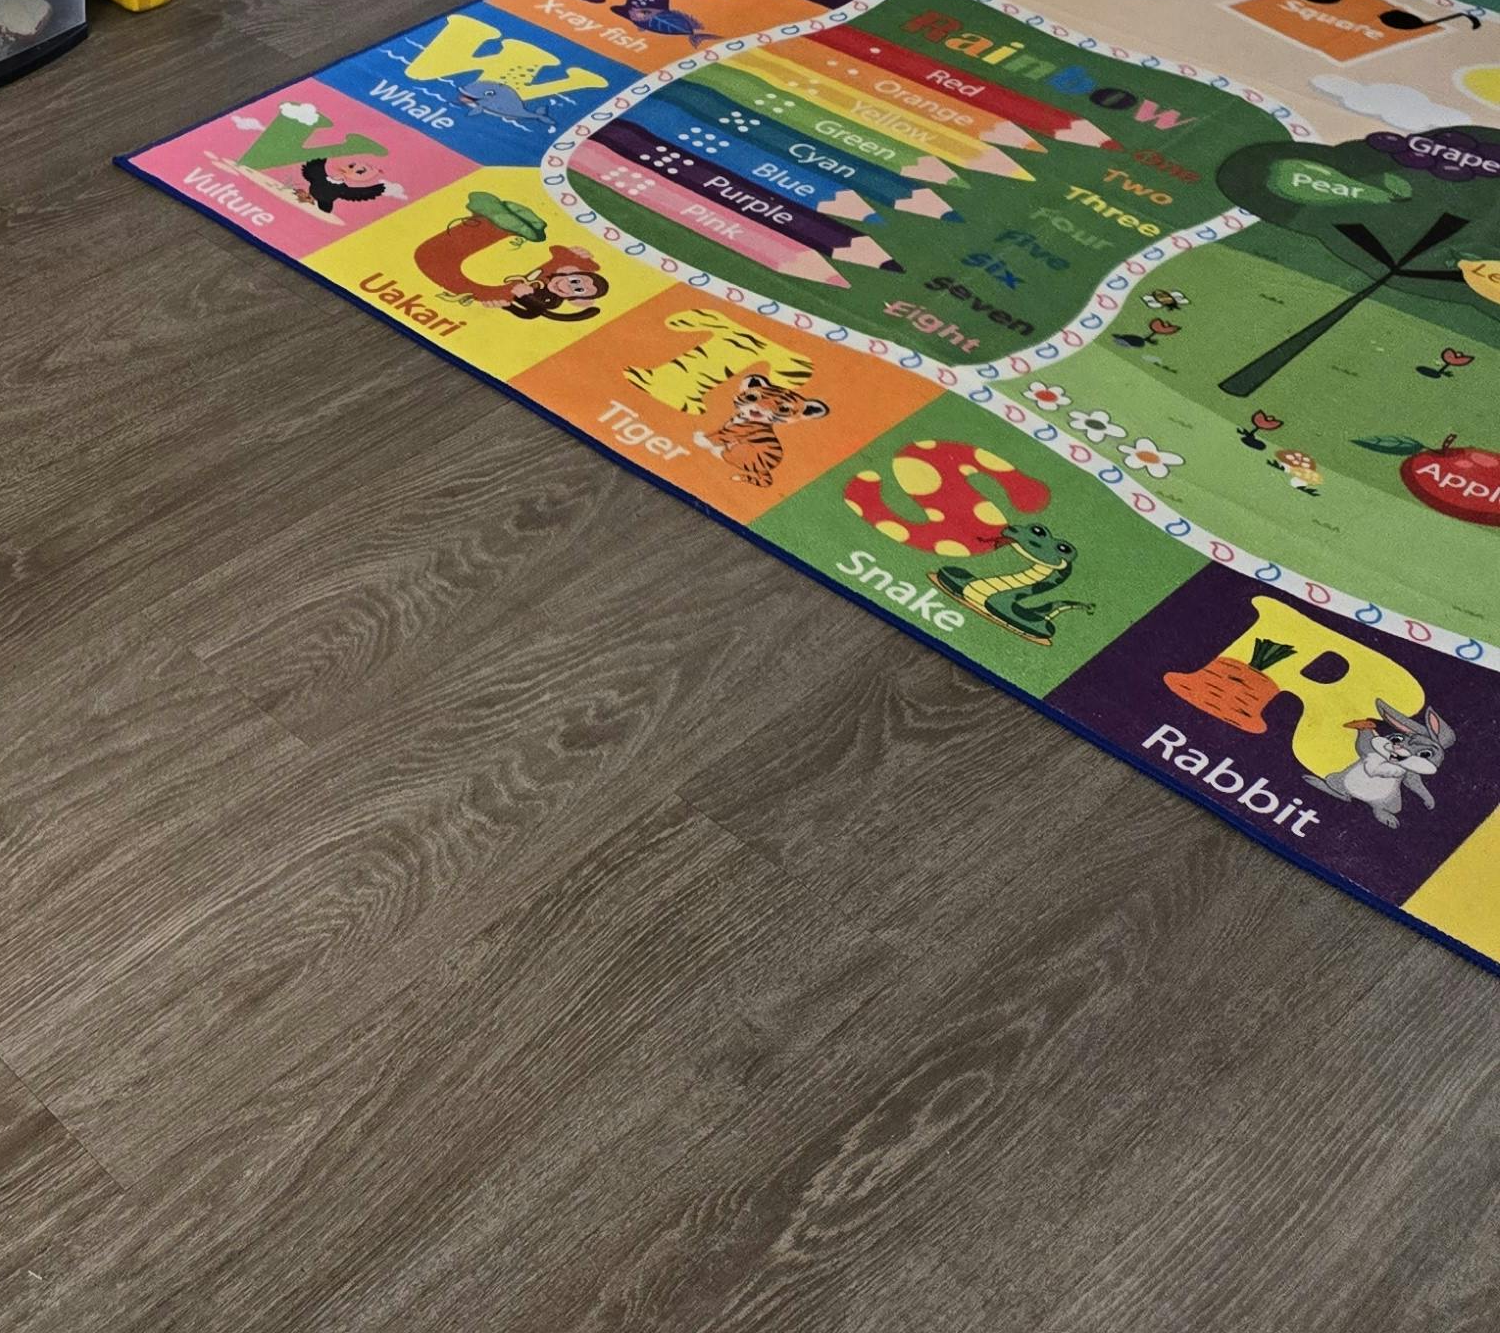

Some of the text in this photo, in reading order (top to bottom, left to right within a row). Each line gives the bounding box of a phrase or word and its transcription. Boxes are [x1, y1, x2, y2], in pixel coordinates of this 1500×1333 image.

[601, 25, 649, 54] fish
[903, 9, 1198, 131] Rainbow
[926, 68, 986, 98] Red
[368, 78, 455, 130] Whale
[849, 99, 936, 146] Yellow
[873, 78, 975, 127] Orange
[787, 142, 857, 180] Cyan
[814, 118, 897, 162] Green
[751, 161, 816, 198] Blue
[1101, 167, 1174, 206] Two
[1131, 148, 1200, 183] One
[1291, 171, 1366, 201] Pear
[181, 167, 276, 227] Vulture
[702, 175, 795, 227] Purple
[1062, 184, 1162, 238] Three
[679, 202, 748, 241] Pink
[1029, 205, 1116, 249] Four
[994, 229, 1071, 271] Five
[359, 271, 467, 338] Uakari
[883, 300, 981, 353] Eight
[596, 399, 691, 464] Tiger
[1415, 462, 1500, 503] Appl
[836, 548, 967, 633] Snake
[1141, 722, 1321, 839] Rabbit
